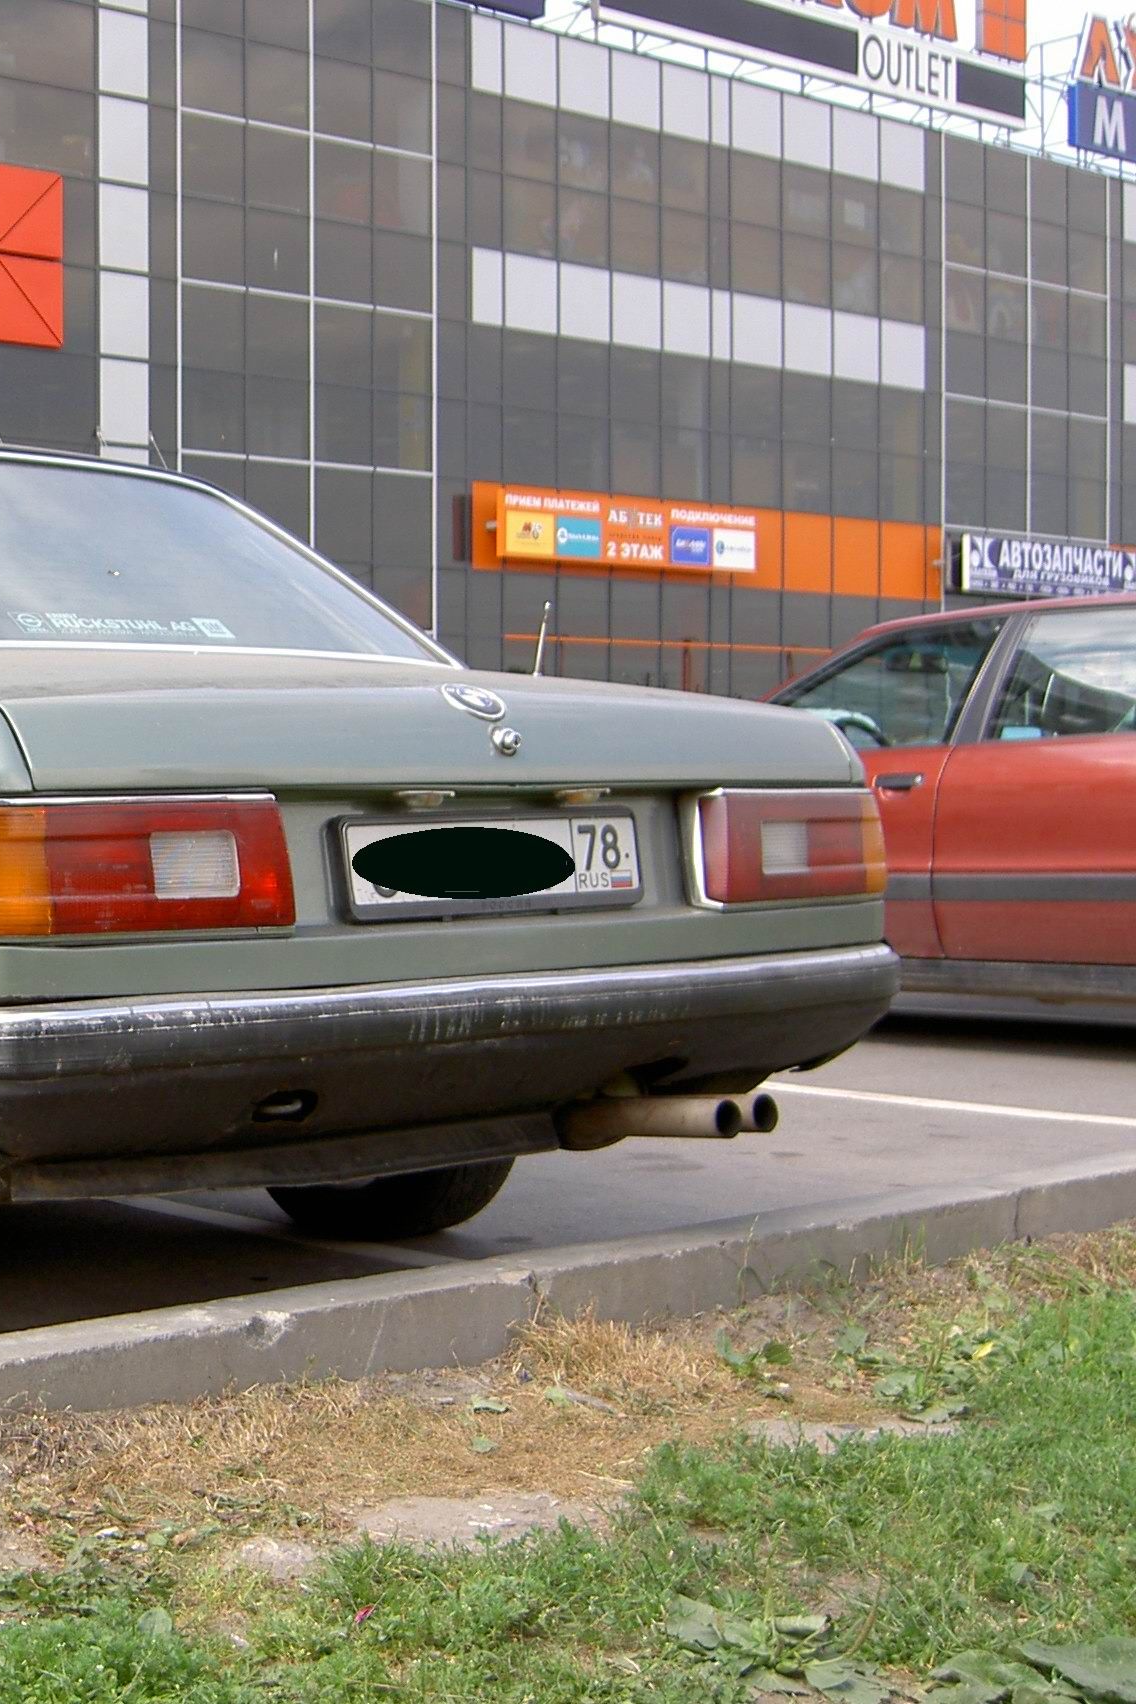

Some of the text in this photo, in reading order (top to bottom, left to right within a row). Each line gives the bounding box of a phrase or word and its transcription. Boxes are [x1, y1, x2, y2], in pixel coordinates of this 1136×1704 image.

[862, 34, 953, 102] OUTLET
[504, 493, 600, 512] ПРИЕМ ПЛАТЕЖЕЙ
[670, 508, 755, 526] ПОДКЛЮЧЕНИЕ
[607, 541, 617, 557] 2
[621, 543, 664, 560] ЭТАЖ
[999, 540, 1124, 578] АВТОЗАПЧАСТИ
[577, 824, 621, 871] 78
[578, 872, 610, 889] RUS
